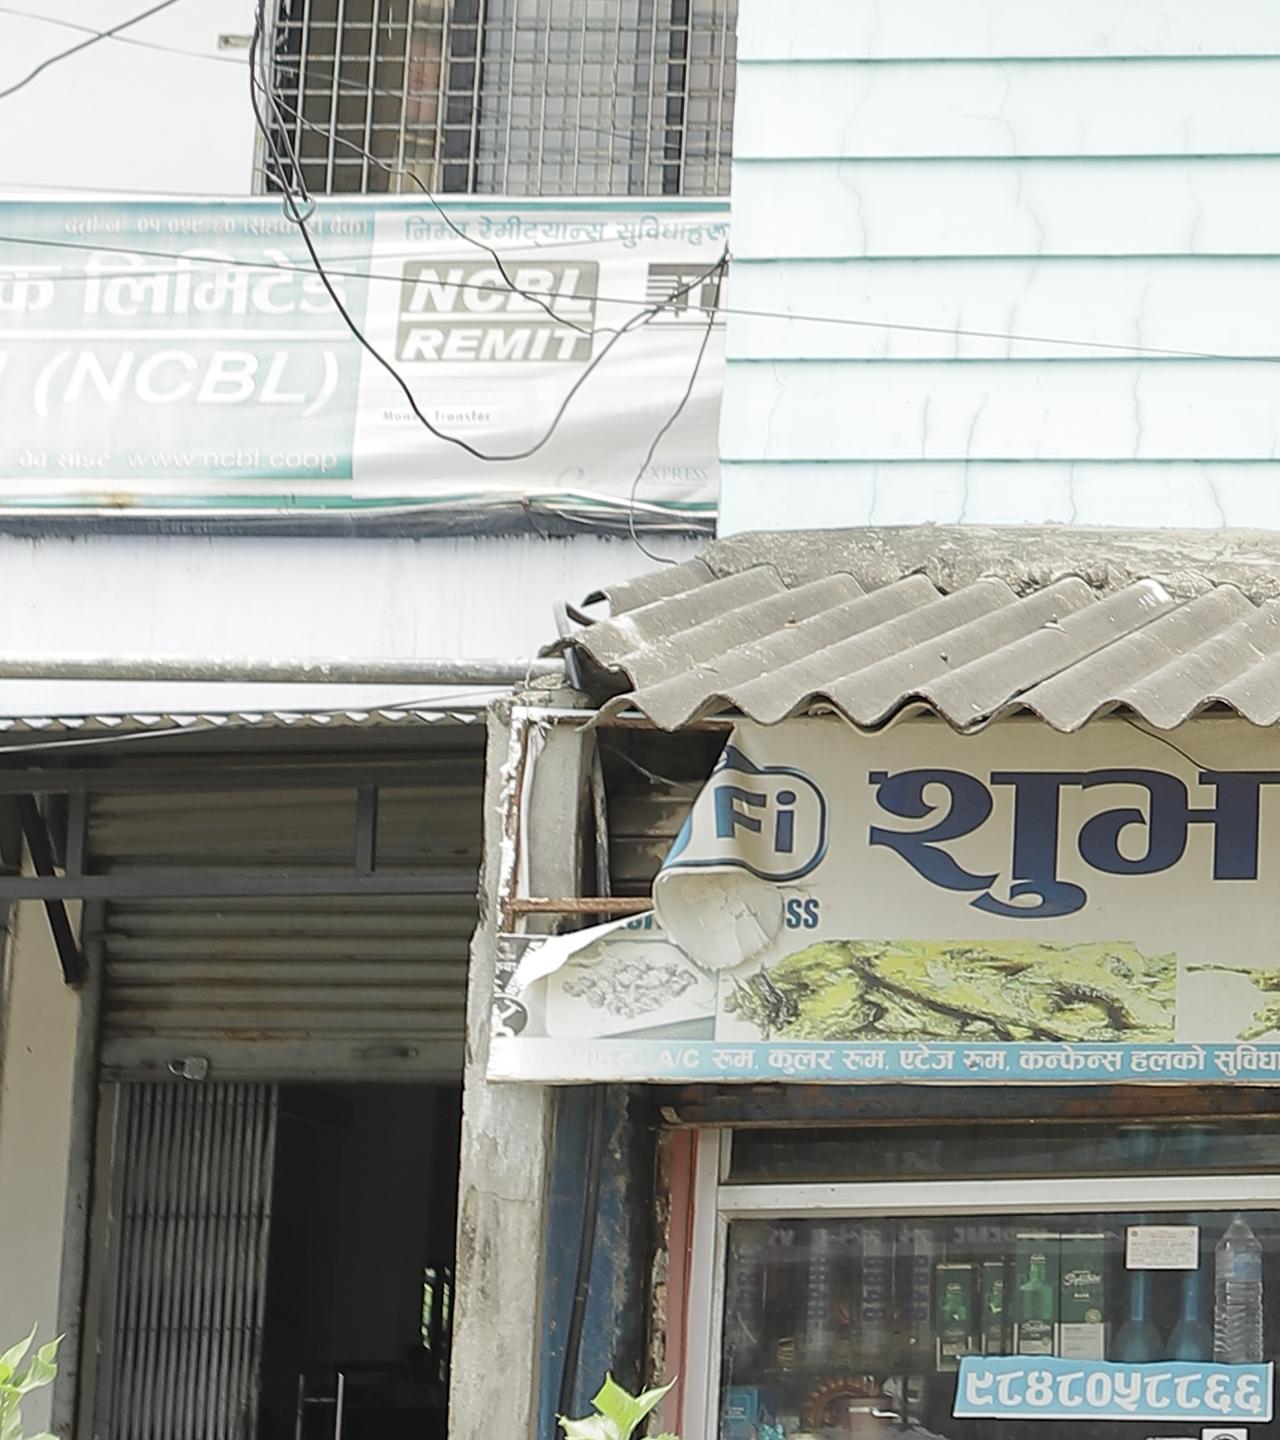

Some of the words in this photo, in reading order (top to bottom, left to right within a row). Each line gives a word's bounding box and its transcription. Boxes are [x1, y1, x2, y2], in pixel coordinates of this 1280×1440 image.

[408, 263, 595, 314] NCBL
[402, 328, 590, 361] REMIT
[32, 349, 340, 416] (NCBL)
[383, 410, 424, 422] Mone
[126, 448, 338, 473] www.ncbl.coop
[768, 1049, 835, 1074] कुलर
[896, 1042, 956, 1070] एटेज
[1130, 1045, 1207, 1072] हलको
